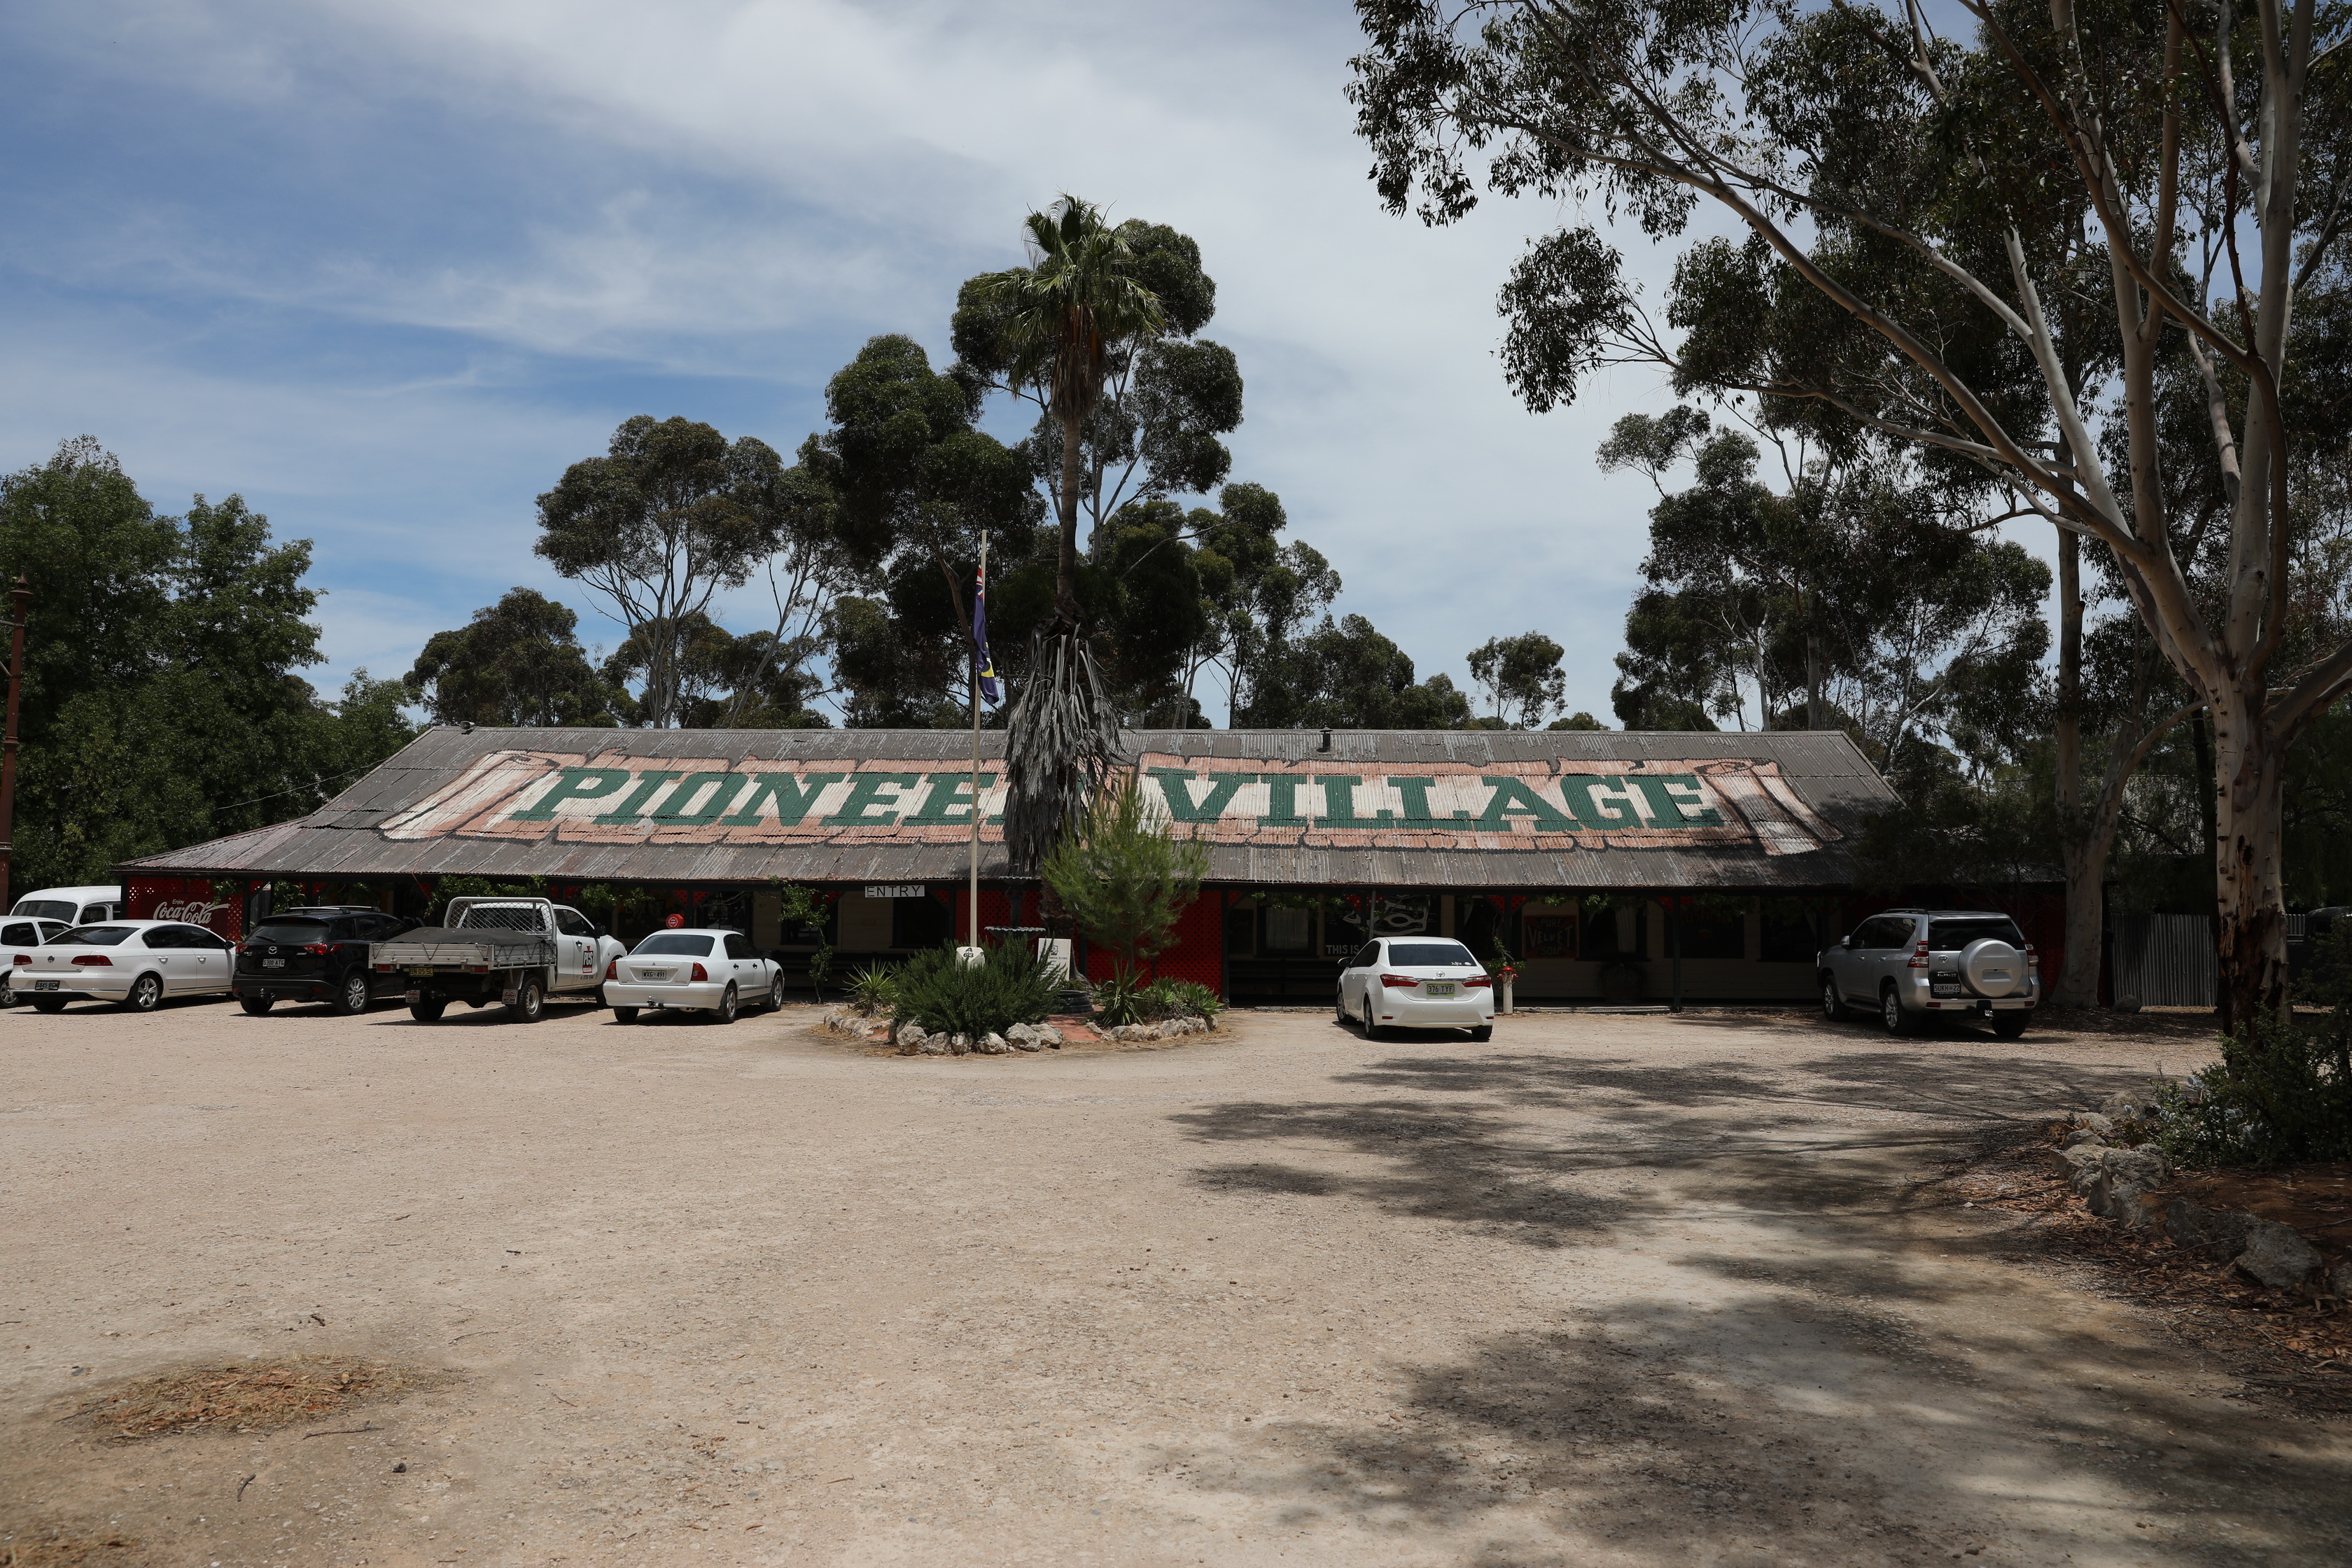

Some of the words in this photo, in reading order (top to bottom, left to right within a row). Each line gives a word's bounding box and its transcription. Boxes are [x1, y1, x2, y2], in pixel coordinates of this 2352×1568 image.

[508, 766, 1087, 827] PIONEE
[1147, 766, 1726, 832] VILLAGE
[867, 886, 920, 897] ENTRY
[153, 902, 230, 924] Coca-Cola
[1540, 918, 1563, 927] PURE
[1527, 923, 1574, 948] VELVET
[1325, 944, 1348, 955] THIS
[1350, 944, 1360, 955] IS
[1541, 946, 1562, 955] SOAP
